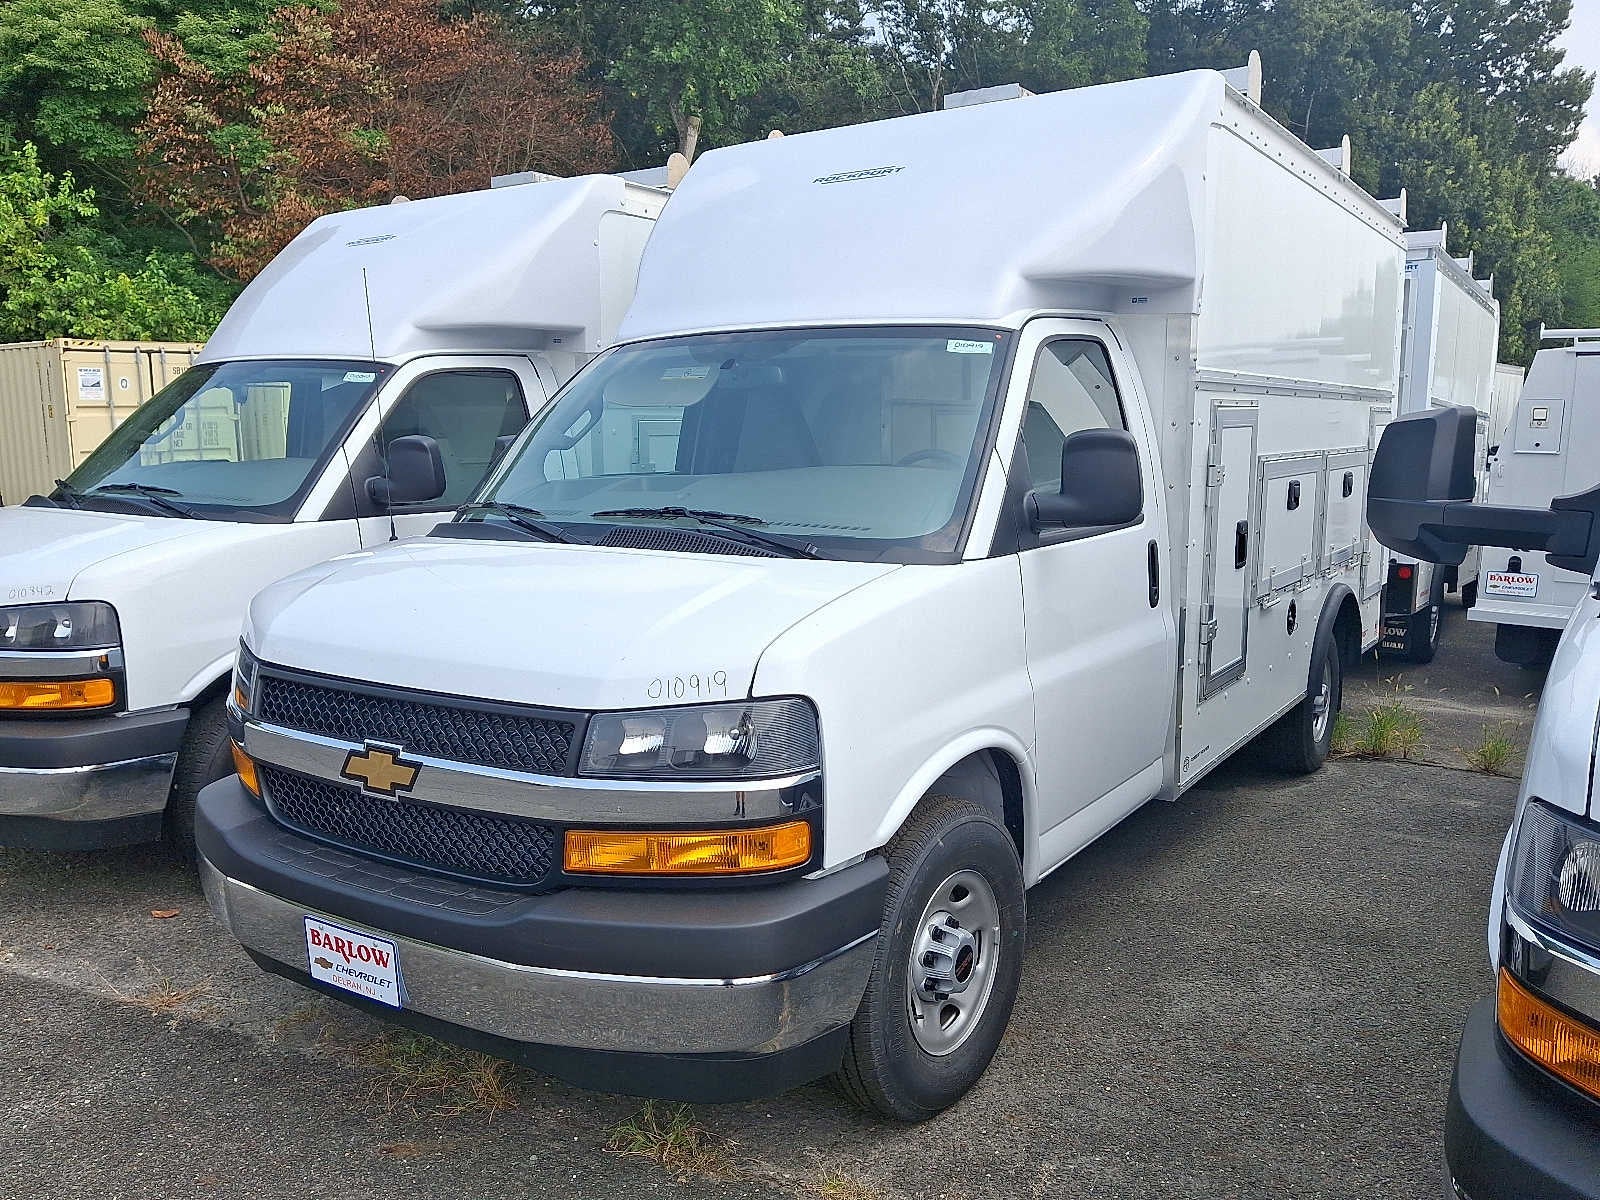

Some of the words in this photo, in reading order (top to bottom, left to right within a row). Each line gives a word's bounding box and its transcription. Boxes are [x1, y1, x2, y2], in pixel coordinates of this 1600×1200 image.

[811, 165, 906, 184] ROCKPORT
[1489, 574, 1536, 585] BARLOW
[1382, 626, 1408, 639] LOW
[647, 670, 727, 699] 010919
[309, 928, 391, 969] BARLOW
[335, 963, 393, 989] CHEVROLET
